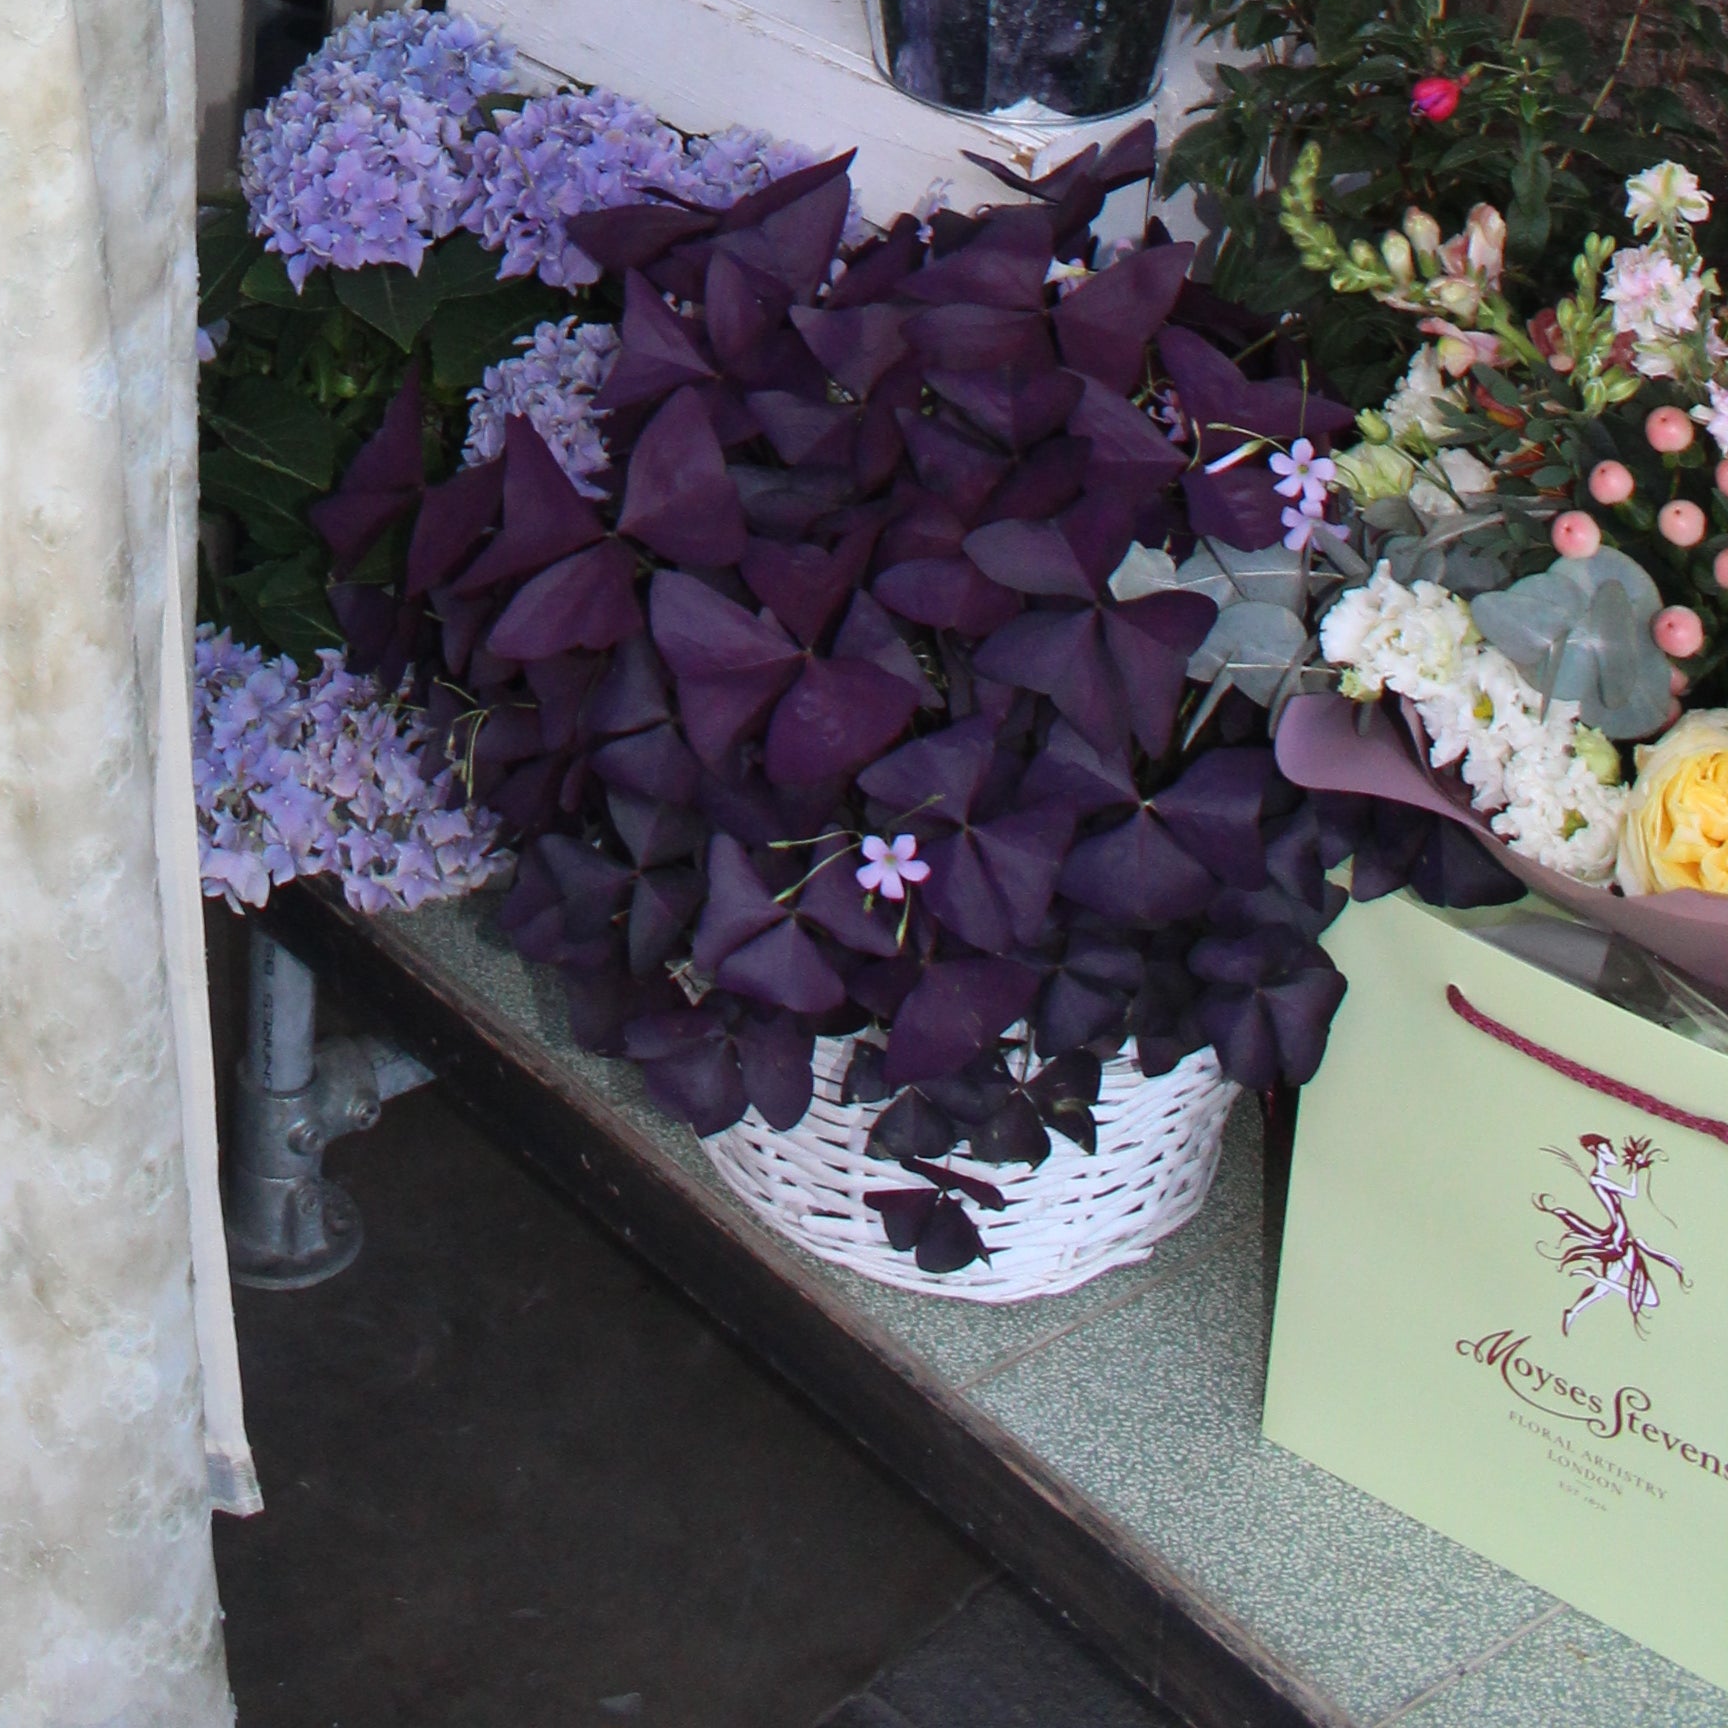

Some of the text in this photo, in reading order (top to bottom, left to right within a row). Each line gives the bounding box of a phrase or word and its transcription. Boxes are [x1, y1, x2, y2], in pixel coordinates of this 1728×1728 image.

[1455, 1329, 1603, 1421] Moyses
[1509, 1410, 1668, 1500] FLORAL ARTISTRY
[1547, 1448, 1623, 1496] LONDON
